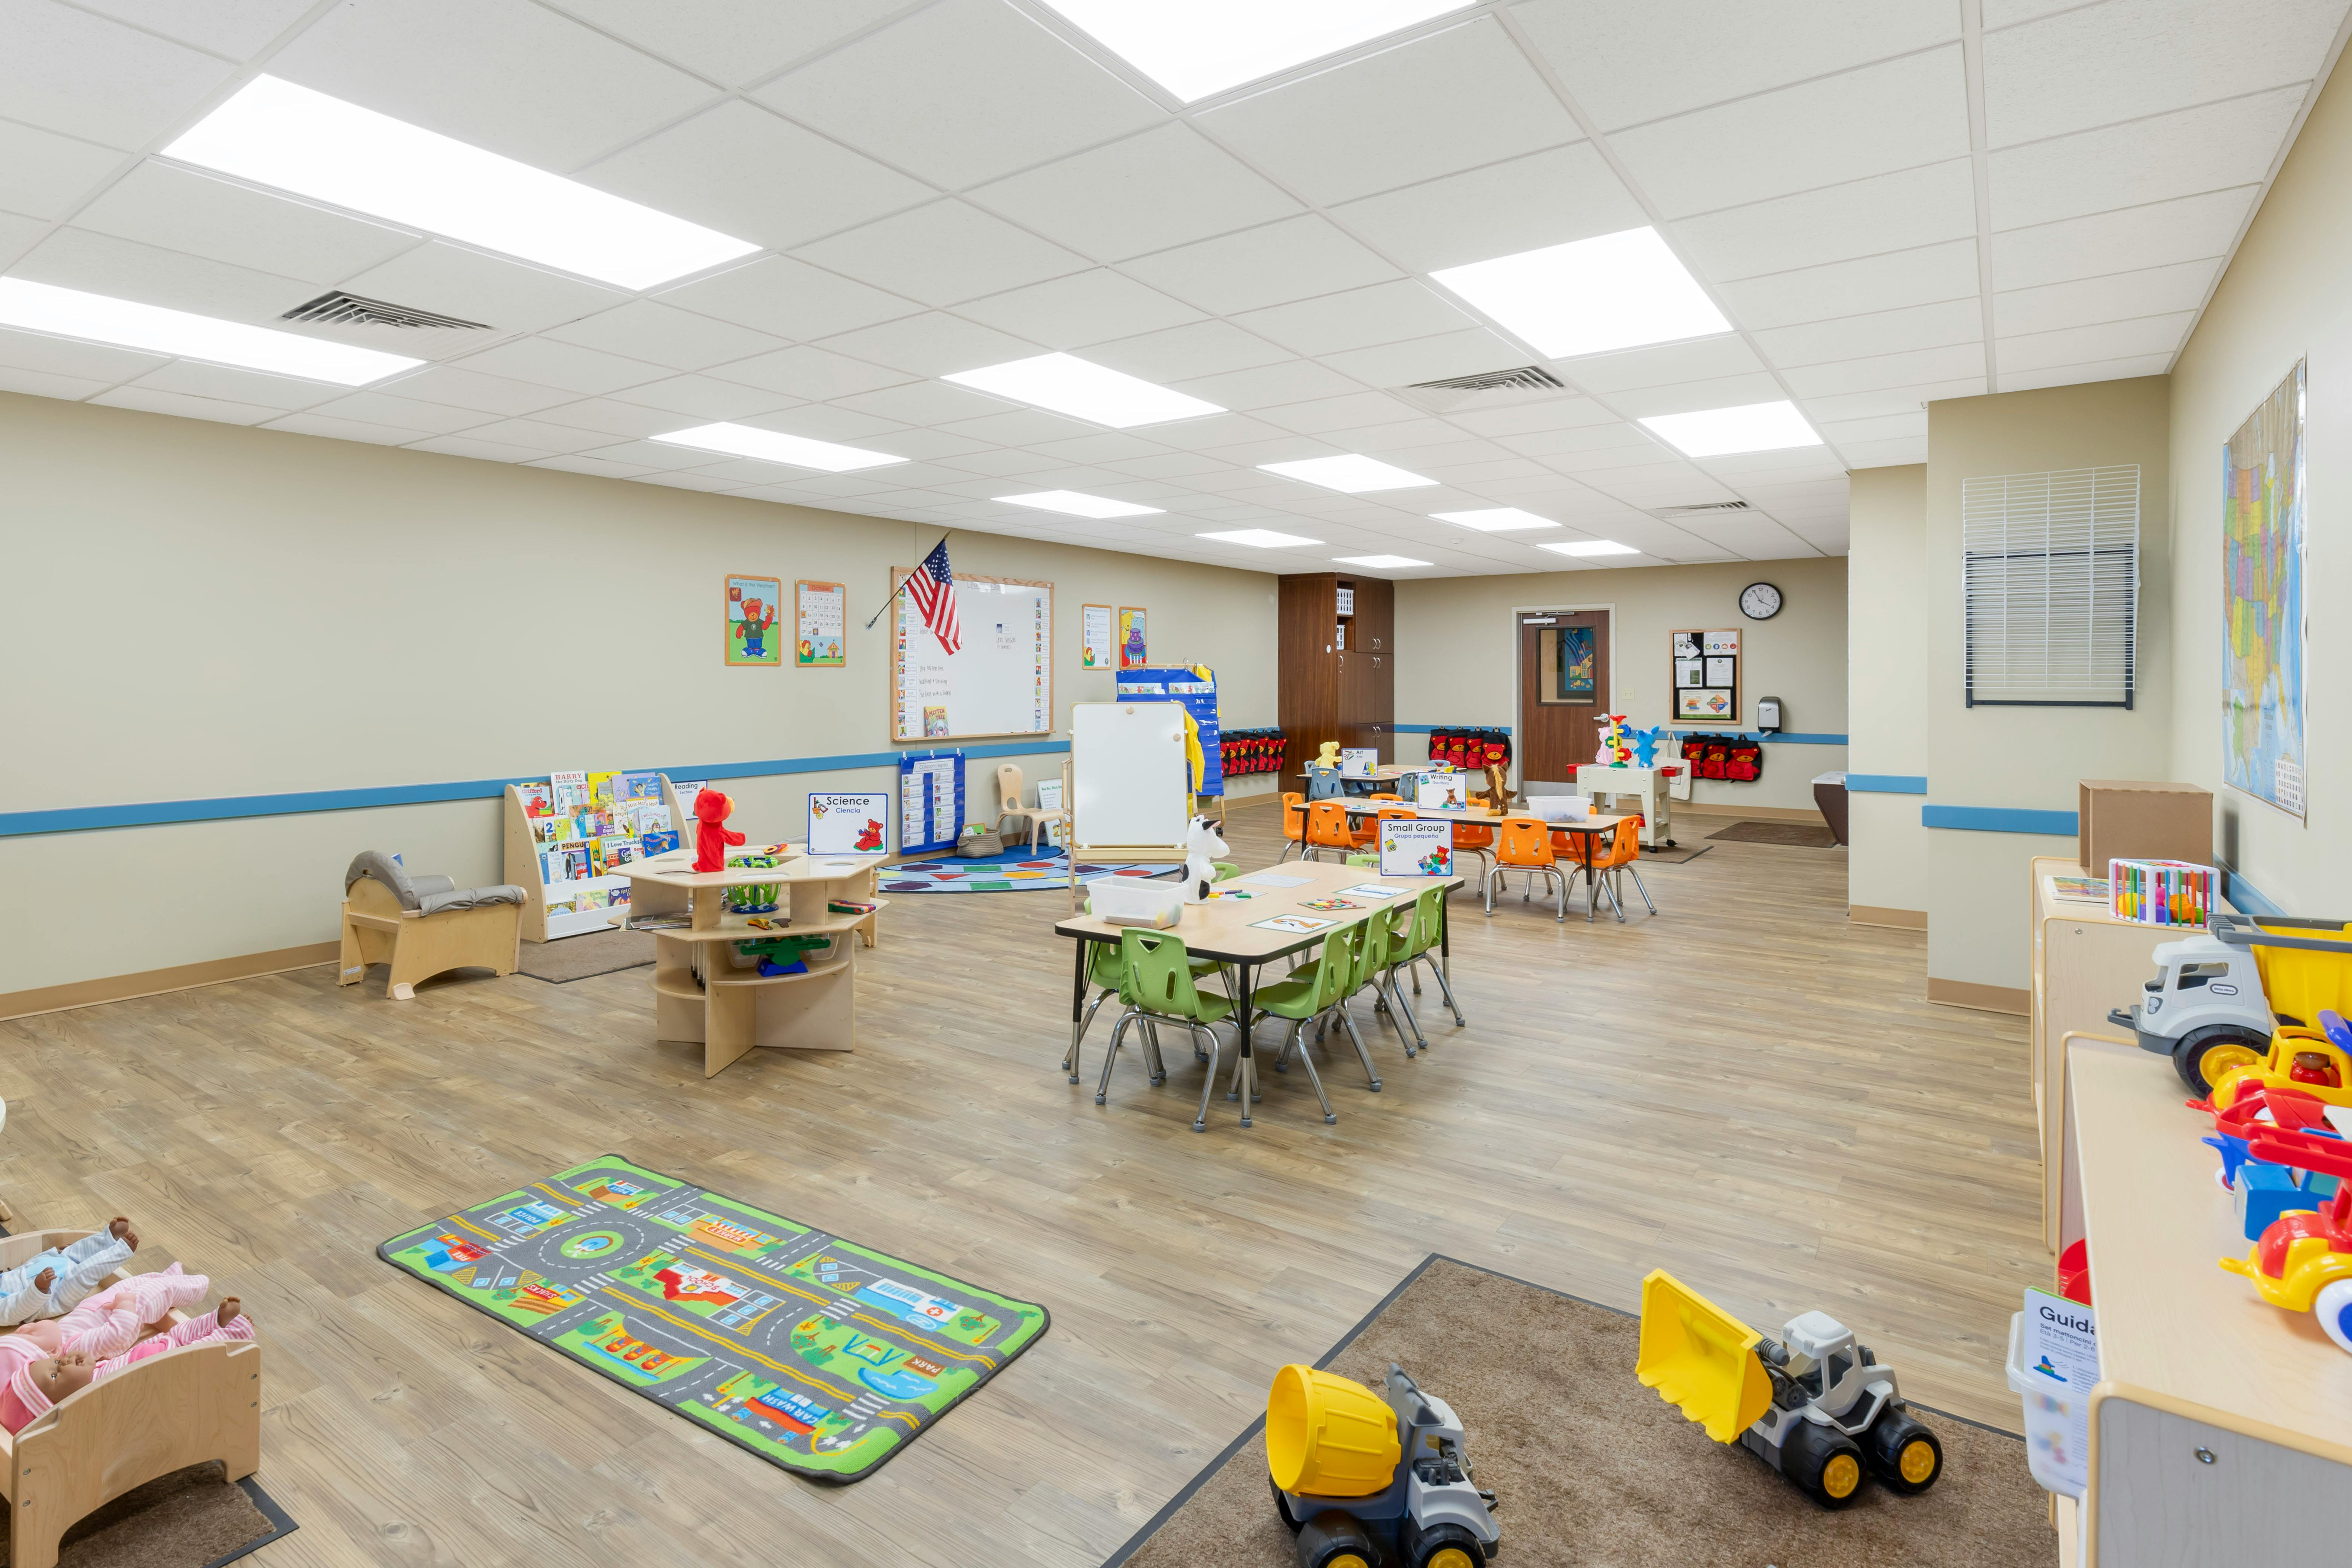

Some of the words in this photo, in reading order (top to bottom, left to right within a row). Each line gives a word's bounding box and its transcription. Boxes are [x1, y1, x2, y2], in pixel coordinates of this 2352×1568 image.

[929, 708, 945, 717] MITTEN
[1430, 773, 1453, 782] Writing
[827, 796, 870, 805] Science
[546, 822, 553, 833] 2
[1416, 824, 1445, 833] Group
[622, 838, 642, 846] Trucks!
[513, 1210, 542, 1223] POLICE
[709, 1227, 743, 1241] MARKET
[452, 1251, 471, 1261] FIRE
[686, 1275, 720, 1290] SCHOOL
[527, 1284, 557, 1299] SNACKS
[2040, 1323, 2052, 1331] Set
[2053, 1329, 2091, 1344] mattoncini
[2040, 1328, 2051, 1337] Età
[2053, 1333, 2064, 1341] 3-5
[911, 1358, 942, 1374] PARK
[762, 1394, 796, 1412] WASH
[794, 1408, 819, 1424] CAR
